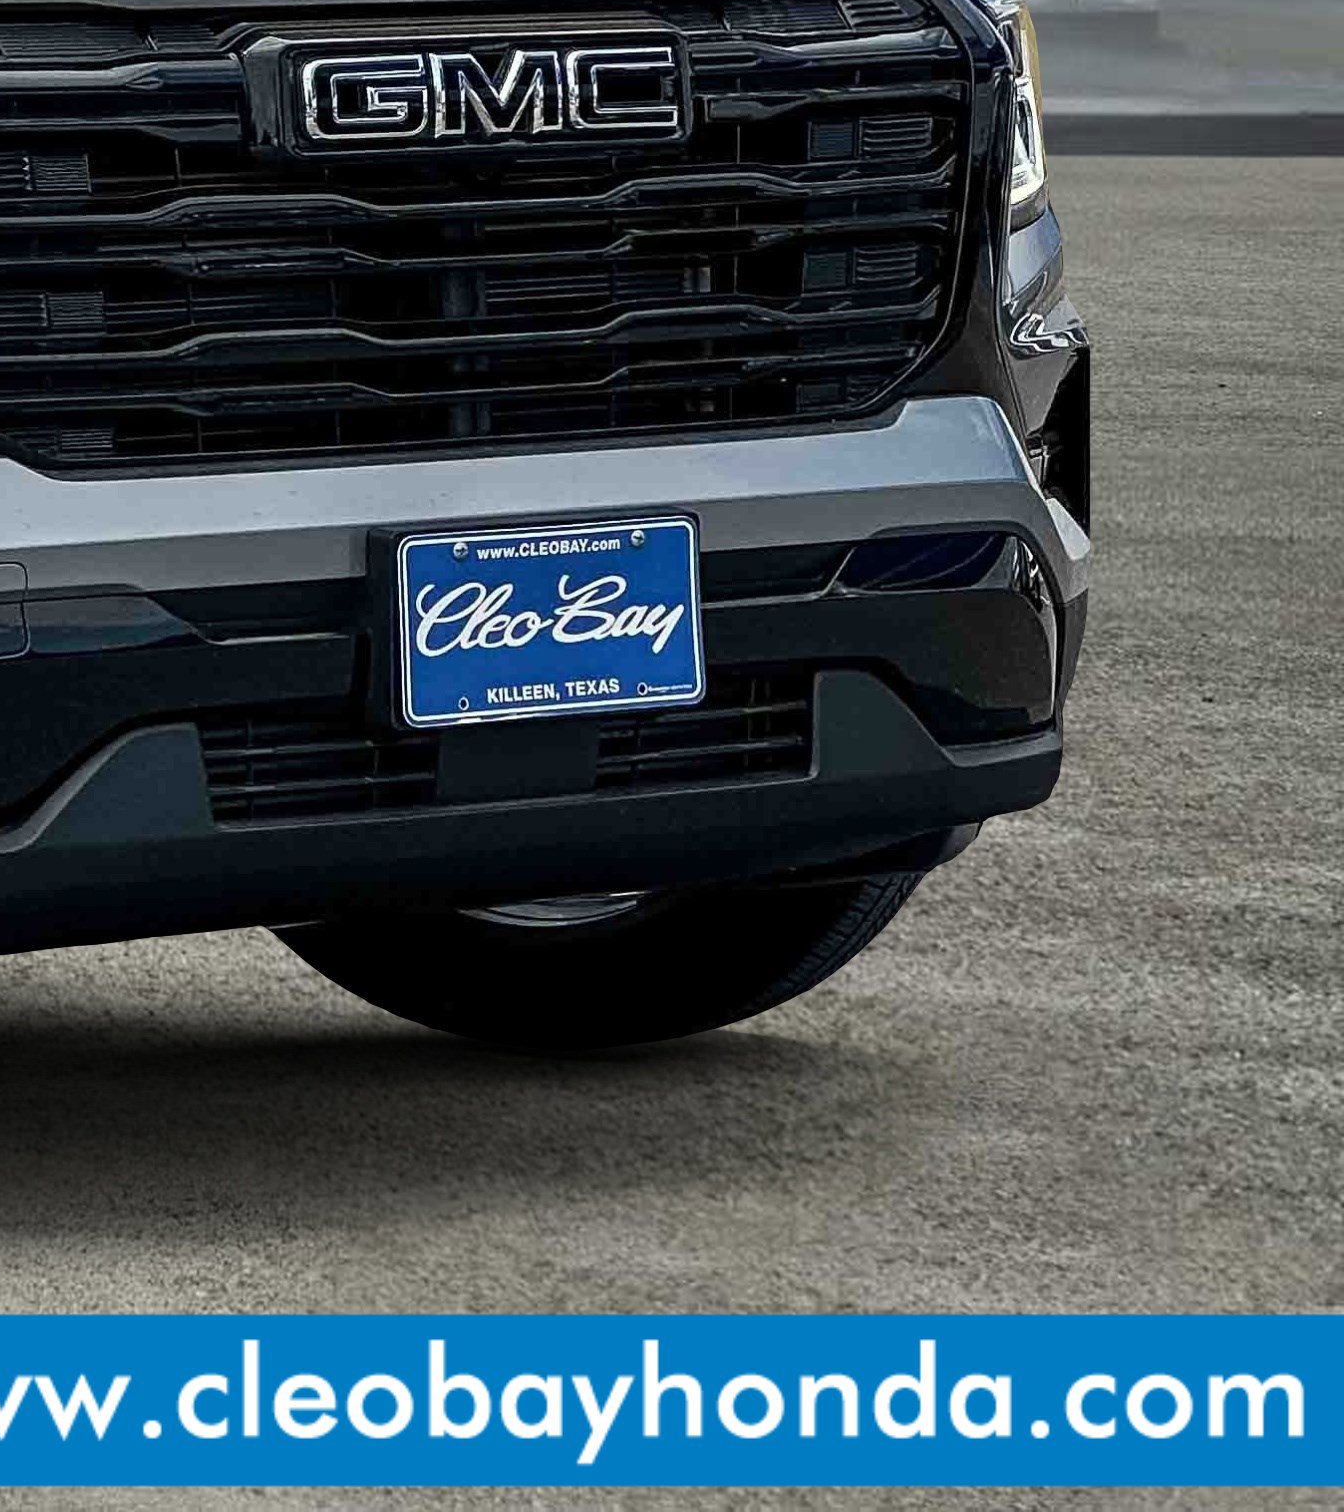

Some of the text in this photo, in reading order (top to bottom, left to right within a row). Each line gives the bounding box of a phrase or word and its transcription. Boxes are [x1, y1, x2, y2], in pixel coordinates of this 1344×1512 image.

[301, 46, 678, 140] GMC
[477, 537, 621, 560] www.CLEOBAY.com
[415, 574, 685, 657] Cleo Bay
[486, 678, 621, 705] KILLEEN, TEXAS
